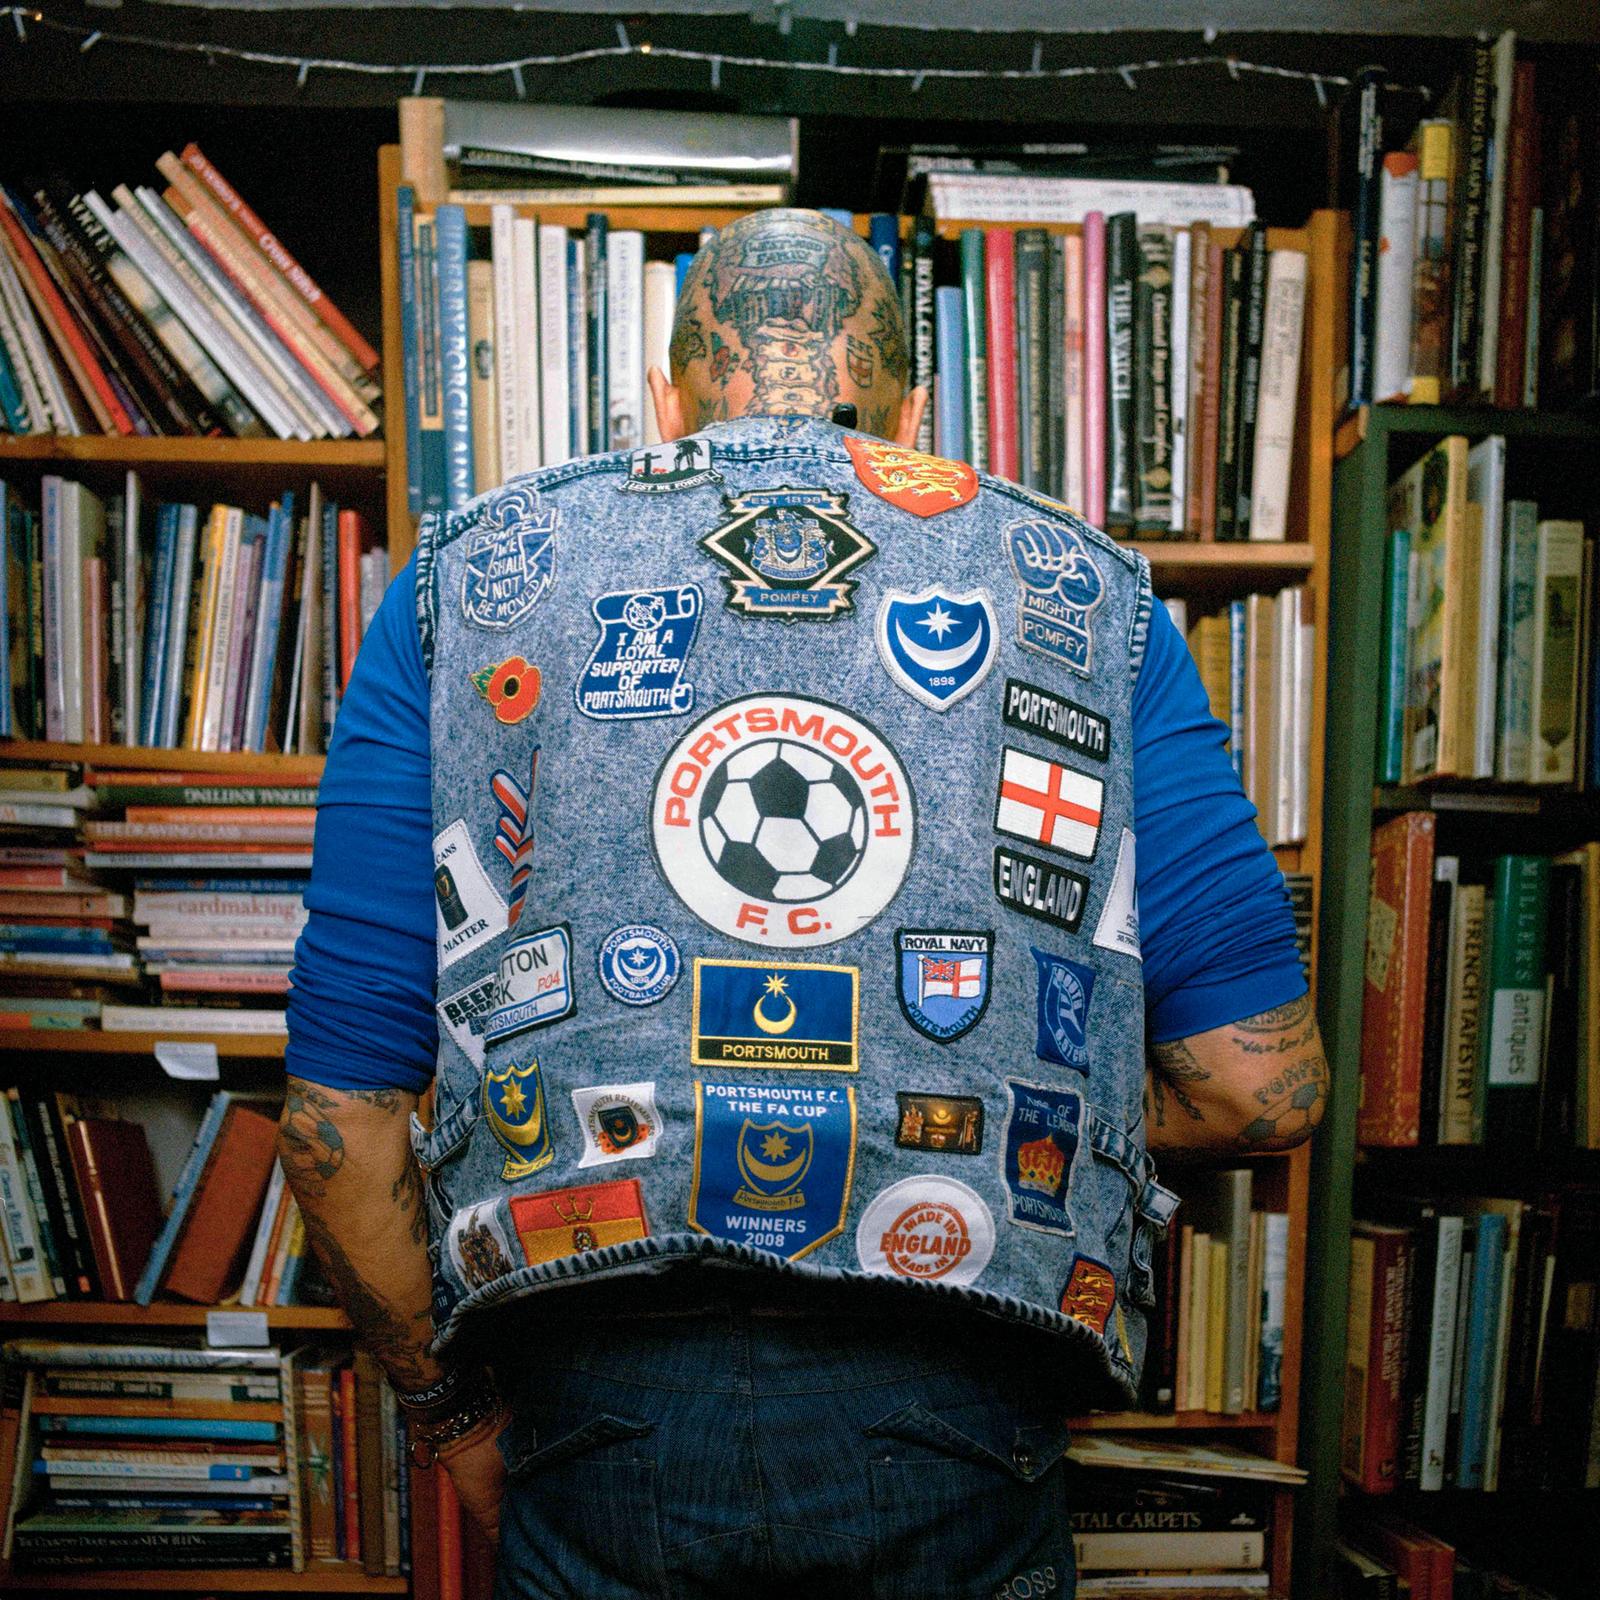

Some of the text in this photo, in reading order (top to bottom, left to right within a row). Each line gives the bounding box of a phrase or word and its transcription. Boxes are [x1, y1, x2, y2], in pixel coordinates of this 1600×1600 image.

[476, 579, 541, 619] BE MOVED
[493, 575, 523, 601] NOT
[760, 592, 820, 603] POMPEY
[1027, 593, 1084, 628] MIGHTY
[619, 628, 674, 646] I AM A
[1024, 619, 1087, 658] POMPEY
[615, 645, 667, 660] LOYAL
[589, 658, 680, 677] SUPPORTER
[618, 674, 641, 690] OF
[927, 676, 956, 687] 1898
[584, 687, 671, 710] PORTSMOUTH
[1008, 684, 1105, 752] PORTSMOUTH
[664, 706, 902, 838] PORTSMOUTH
[436, 843, 457, 865] CANS
[998, 856, 1082, 923] ENGLAND
[177, 895, 297, 923] cardmaking
[736, 902, 832, 935] F. C.
[442, 918, 489, 954] MATTER
[606, 928, 671, 955] PORTSMOUTH
[904, 936, 986, 951] ROYAL NAVY
[537, 970, 561, 993] PO4
[609, 974, 671, 999] FOOTBALL CLUB
[906, 1000, 980, 1034] PORTSMOUTH
[1454, 917, 1482, 1102] FRENCH TAPESTRY
[1506, 991, 1534, 1076] antiques
[722, 1043, 829, 1061] PORTSMOUTH
[705, 1084, 844, 1104] PORTSMOUTH F.C.
[727, 1100, 828, 1118] THE FA CUP
[1018, 1107, 1041, 1125] THE
[1057, 1104, 1073, 1119] OF
[725, 1215, 807, 1234] WINNERS
[903, 1210, 959, 1236] MADE IN
[744, 1231, 786, 1248] 2008
[879, 1231, 972, 1258] ENGLAND
[897, 1254, 950, 1273] MADE IN
[1115, 1511, 1202, 1529] CARPETS
